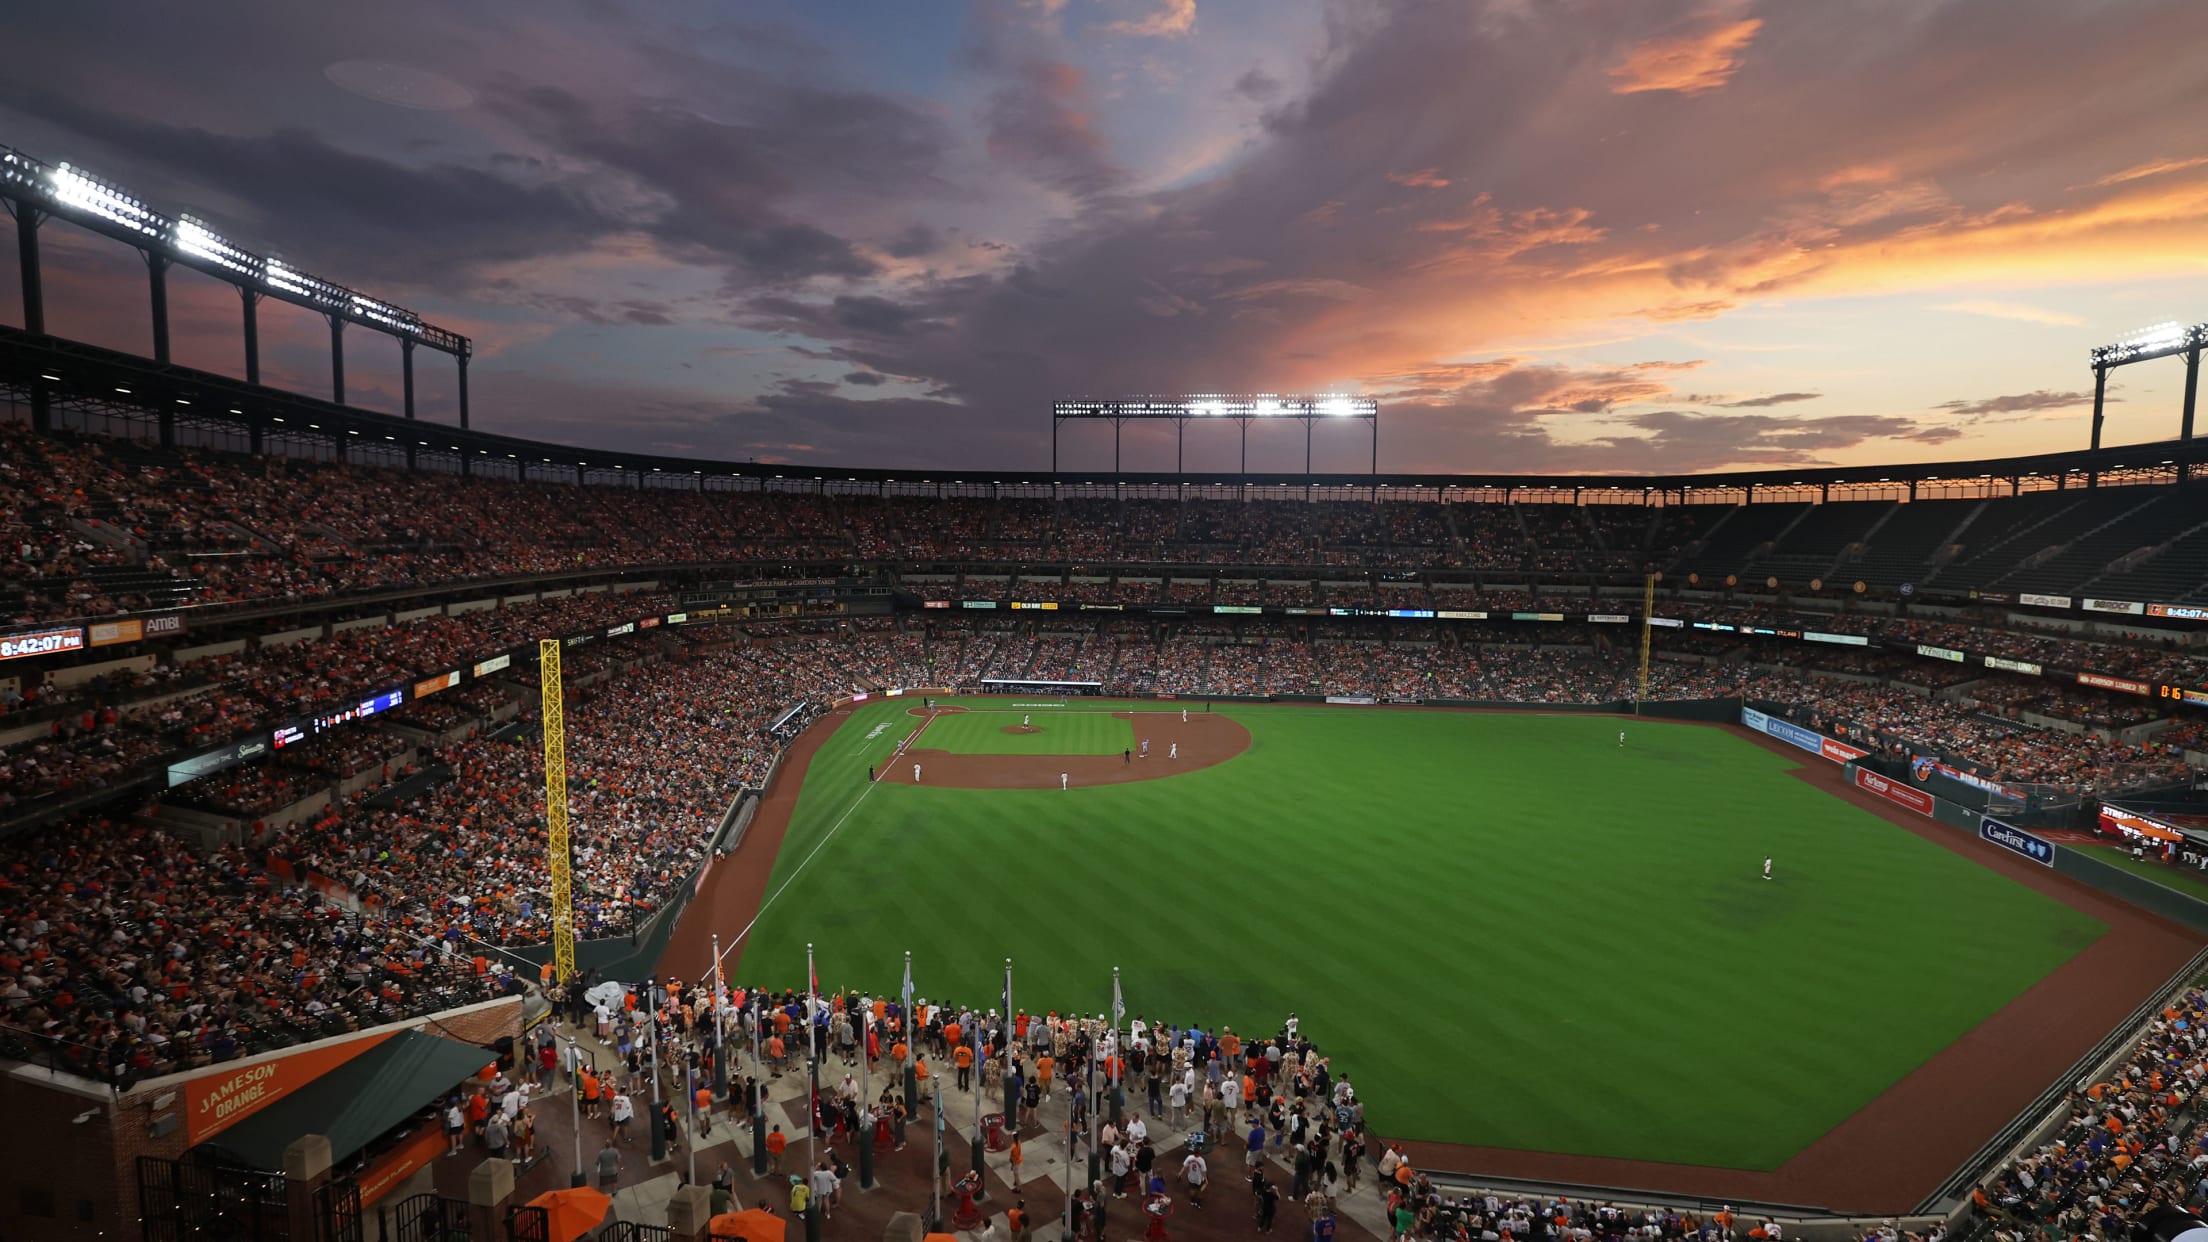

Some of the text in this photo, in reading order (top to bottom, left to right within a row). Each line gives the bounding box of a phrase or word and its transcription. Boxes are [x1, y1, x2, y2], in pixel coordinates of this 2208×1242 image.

[146, 616, 180, 633] AMBI
[2167, 607, 2202, 618] 8:42:07
[1, 635, 80, 657] 8:42:07 PM
[1987, 824, 2026, 850] CareFirst
[200, 1063, 277, 1114] JAMESON
[216, 1081, 265, 1118] ORANGE
